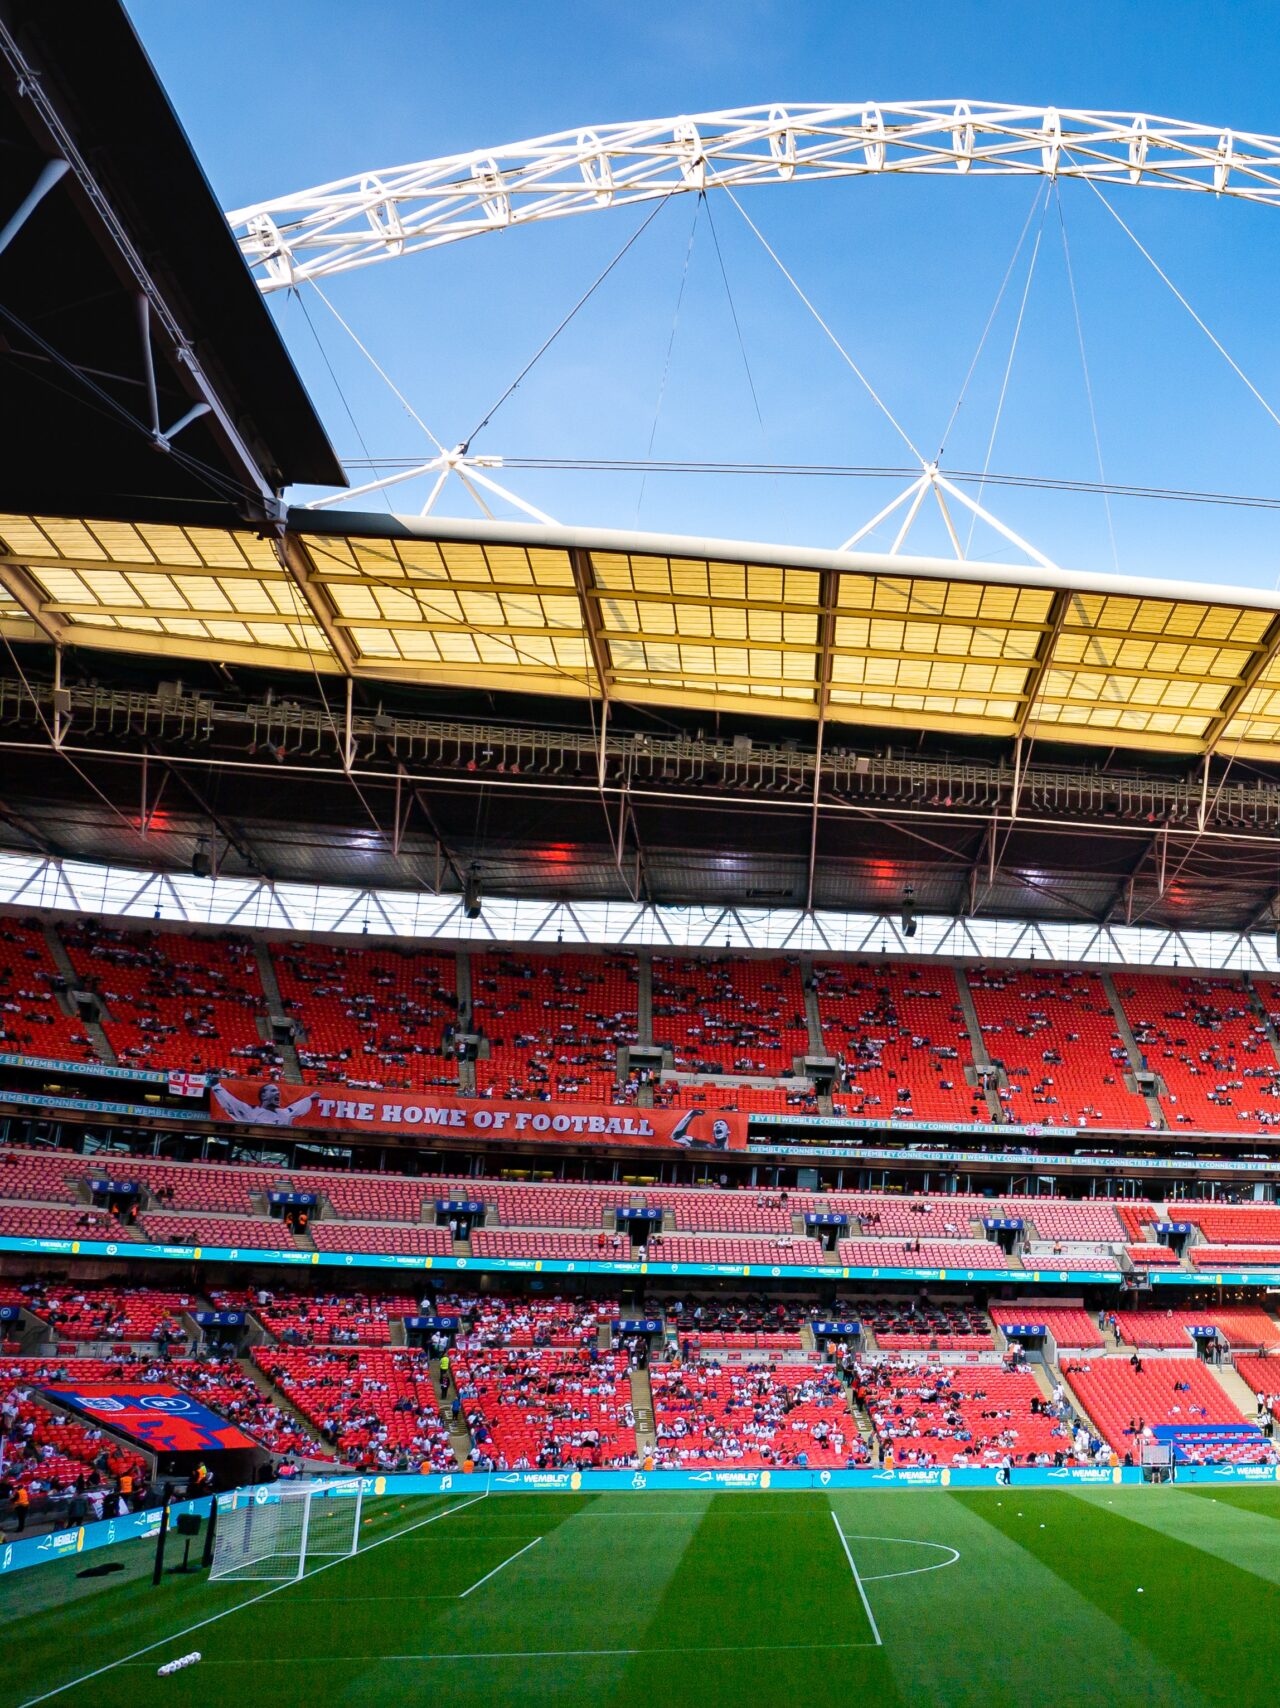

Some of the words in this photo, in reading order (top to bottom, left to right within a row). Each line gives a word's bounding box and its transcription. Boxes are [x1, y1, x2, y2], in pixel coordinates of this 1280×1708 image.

[24, 1059, 72, 1070] WEMBLEY
[72, 1064, 130, 1077] CONNECTED
[0, 1093, 40, 1104] WEMBLEY
[42, 1097, 98, 1109] CONNECTED
[134, 1107, 178, 1117] WEMBLEY
[318, 1100, 374, 1121] THE
[381, 1105, 467, 1127] HOME
[473, 1111, 510, 1129] OF
[515, 1112, 654, 1136] FOOTBALL
[780, 1116, 818, 1124] WEMBLEY
[819, 1118, 865, 1127] CONNECTED
[891, 1121, 928, 1129] WEMBLEY
[928, 1123, 972, 1131] CONNECTED
[750, 1146, 787, 1154] WEMBLEY
[897, 1151, 940, 1159] CONNECTED
[1105, 1158, 1147, 1166] CONNECTED
[716, 1473, 759, 1481] WEMBLEY
[1072, 1469, 1111, 1477] WEMBLEY
[54, 1532, 78, 1547] WEMBLEY
